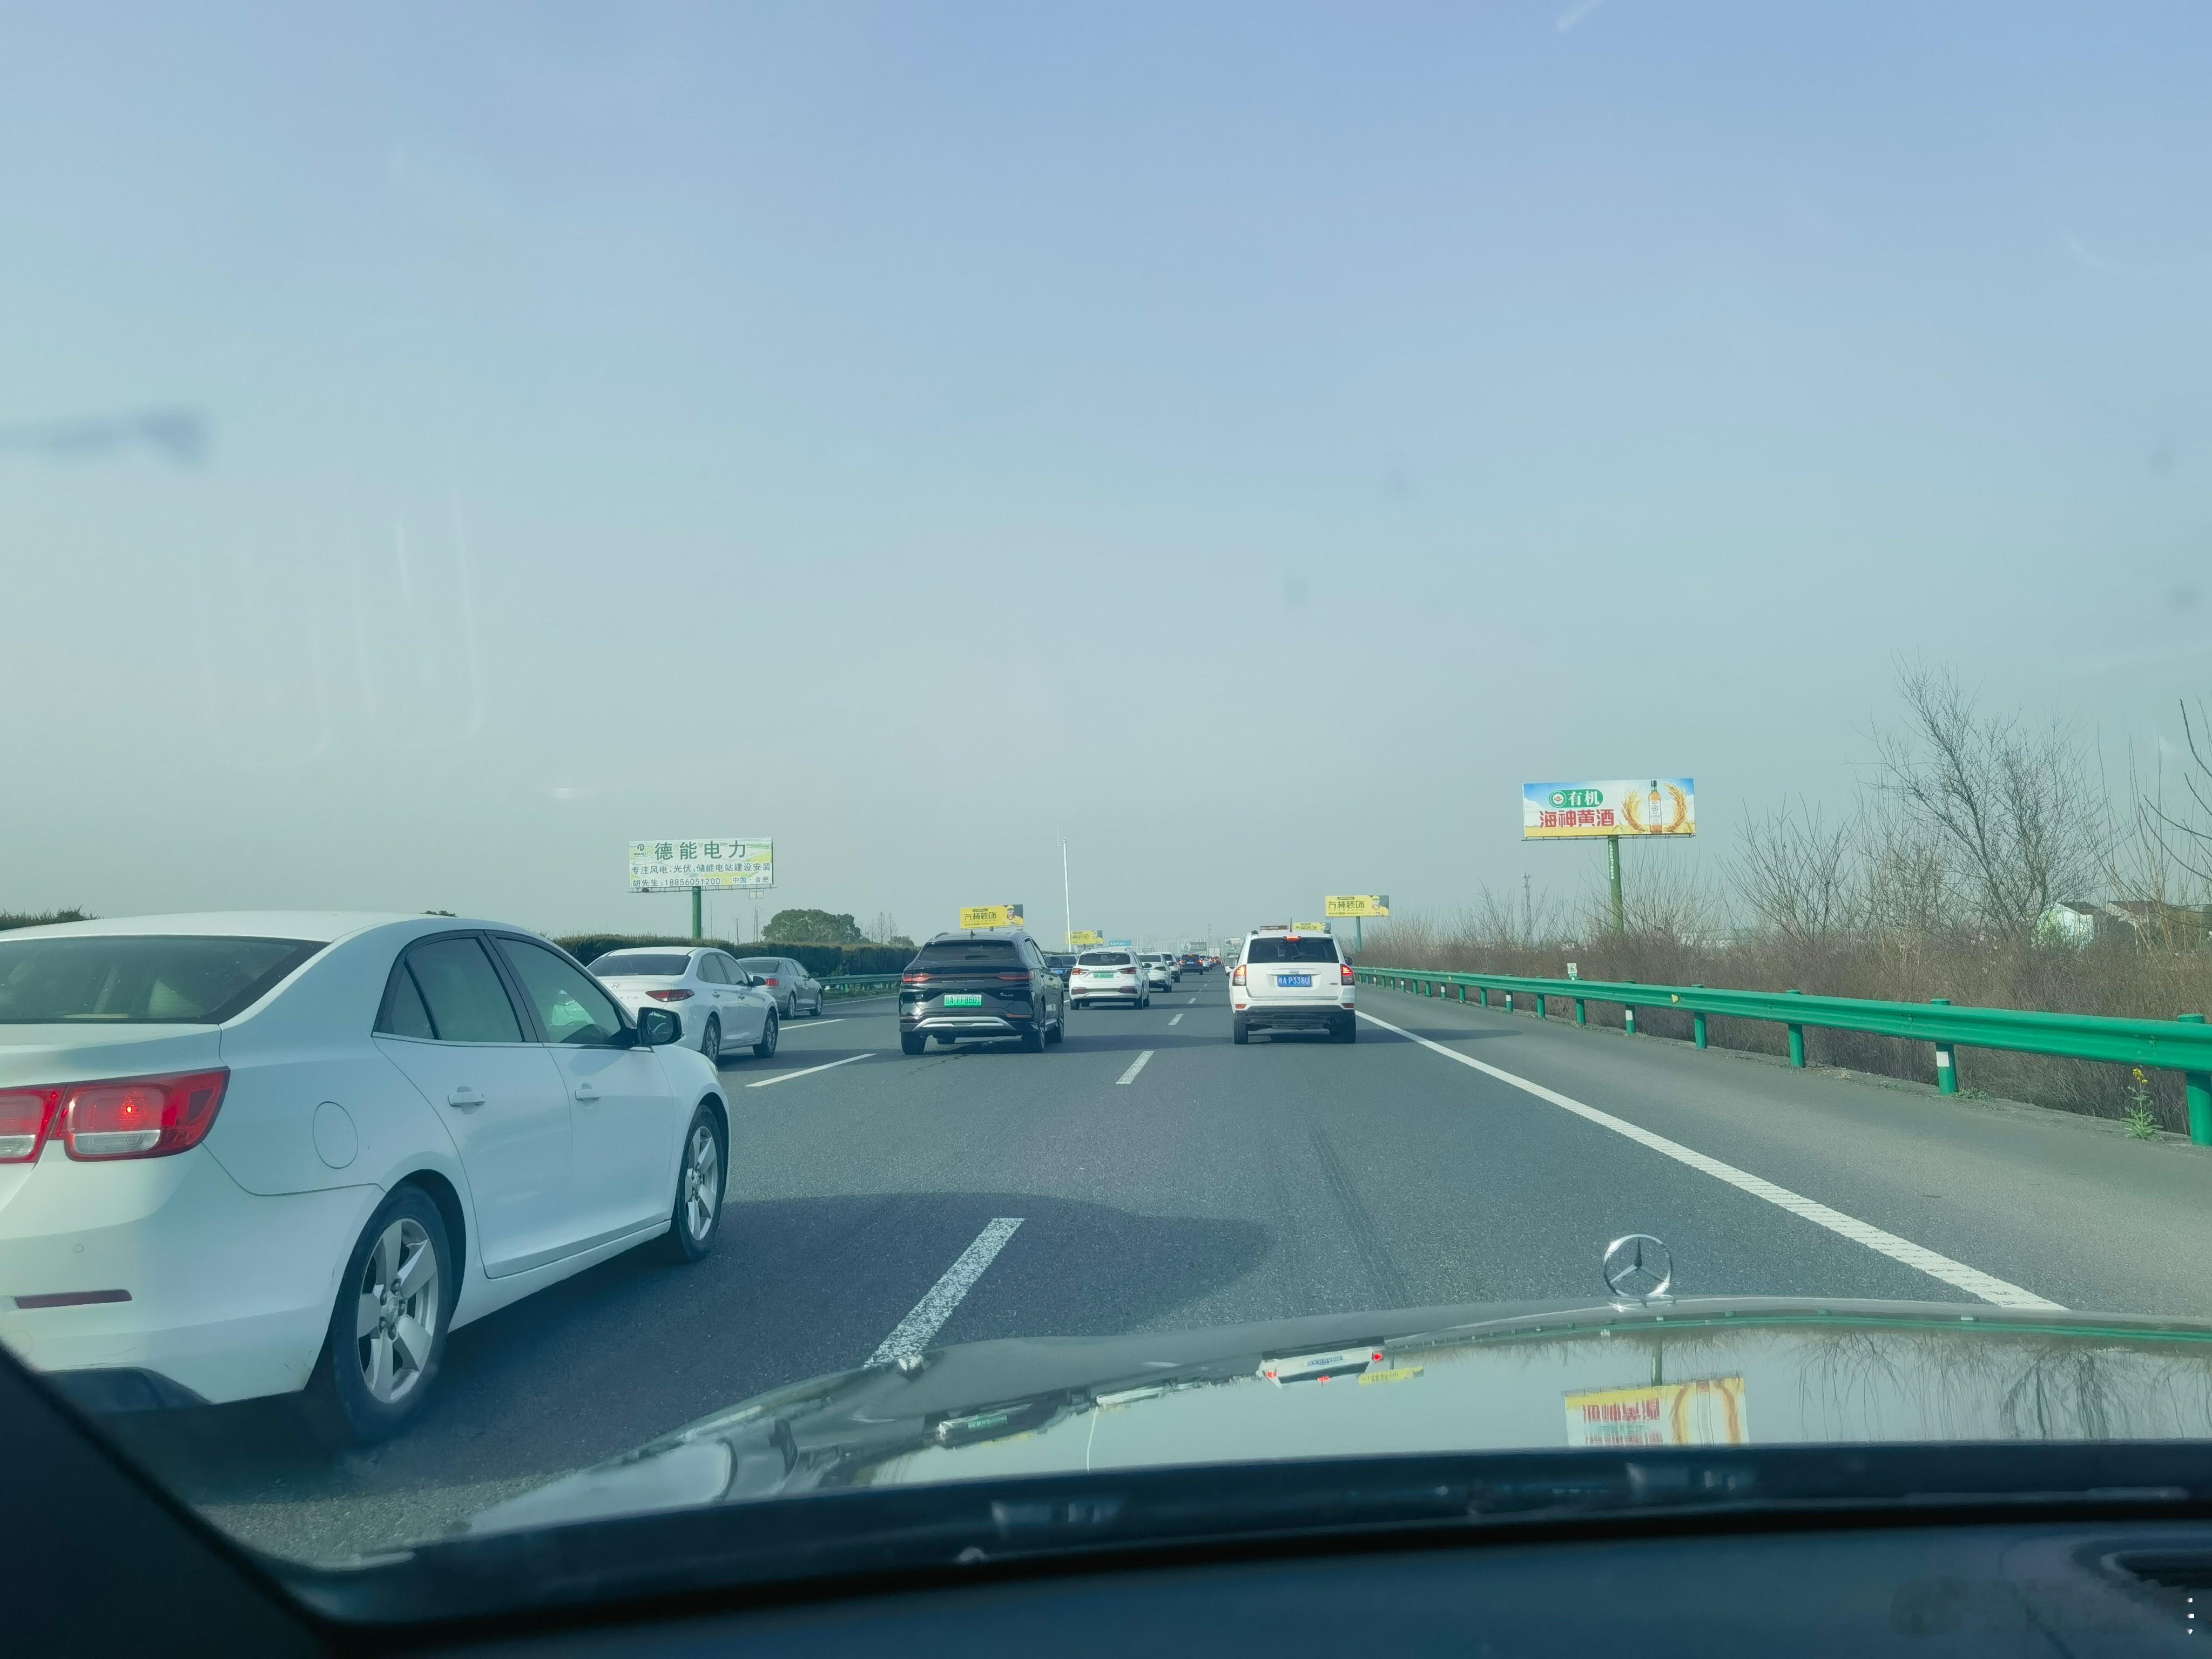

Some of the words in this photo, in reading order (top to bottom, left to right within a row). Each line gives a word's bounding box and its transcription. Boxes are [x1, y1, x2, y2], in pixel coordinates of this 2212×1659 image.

[1567, 791, 1600, 806] 有机
[1539, 809, 1614, 828] 海神黄酒
[654, 840, 747, 860] 德能电力
[631, 862, 771, 875] 专注风电、光伏、储能电站建设安装
